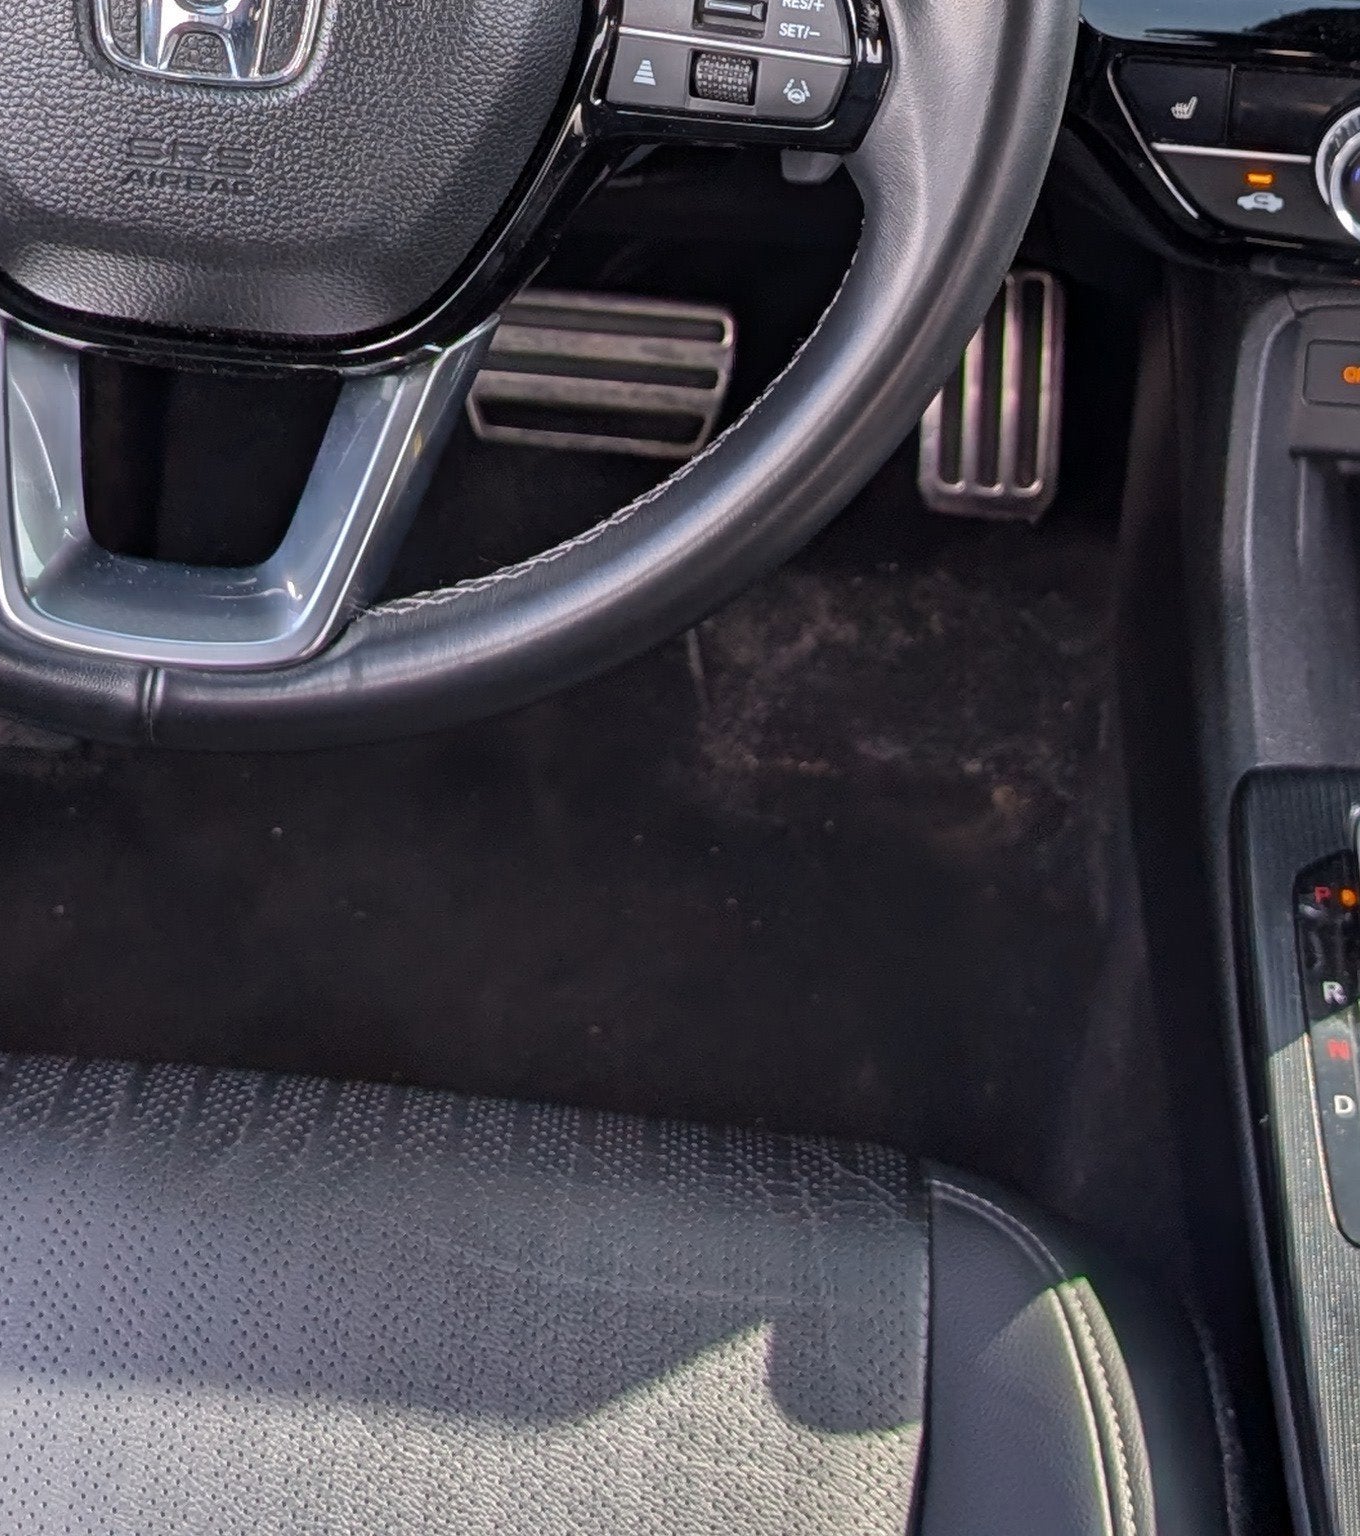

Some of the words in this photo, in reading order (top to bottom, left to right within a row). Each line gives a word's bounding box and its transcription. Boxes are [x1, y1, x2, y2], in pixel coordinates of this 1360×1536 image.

[1314, 886, 1330, 903] P
[1322, 982, 1346, 1003] R
[1334, 1095, 1356, 1115] D
